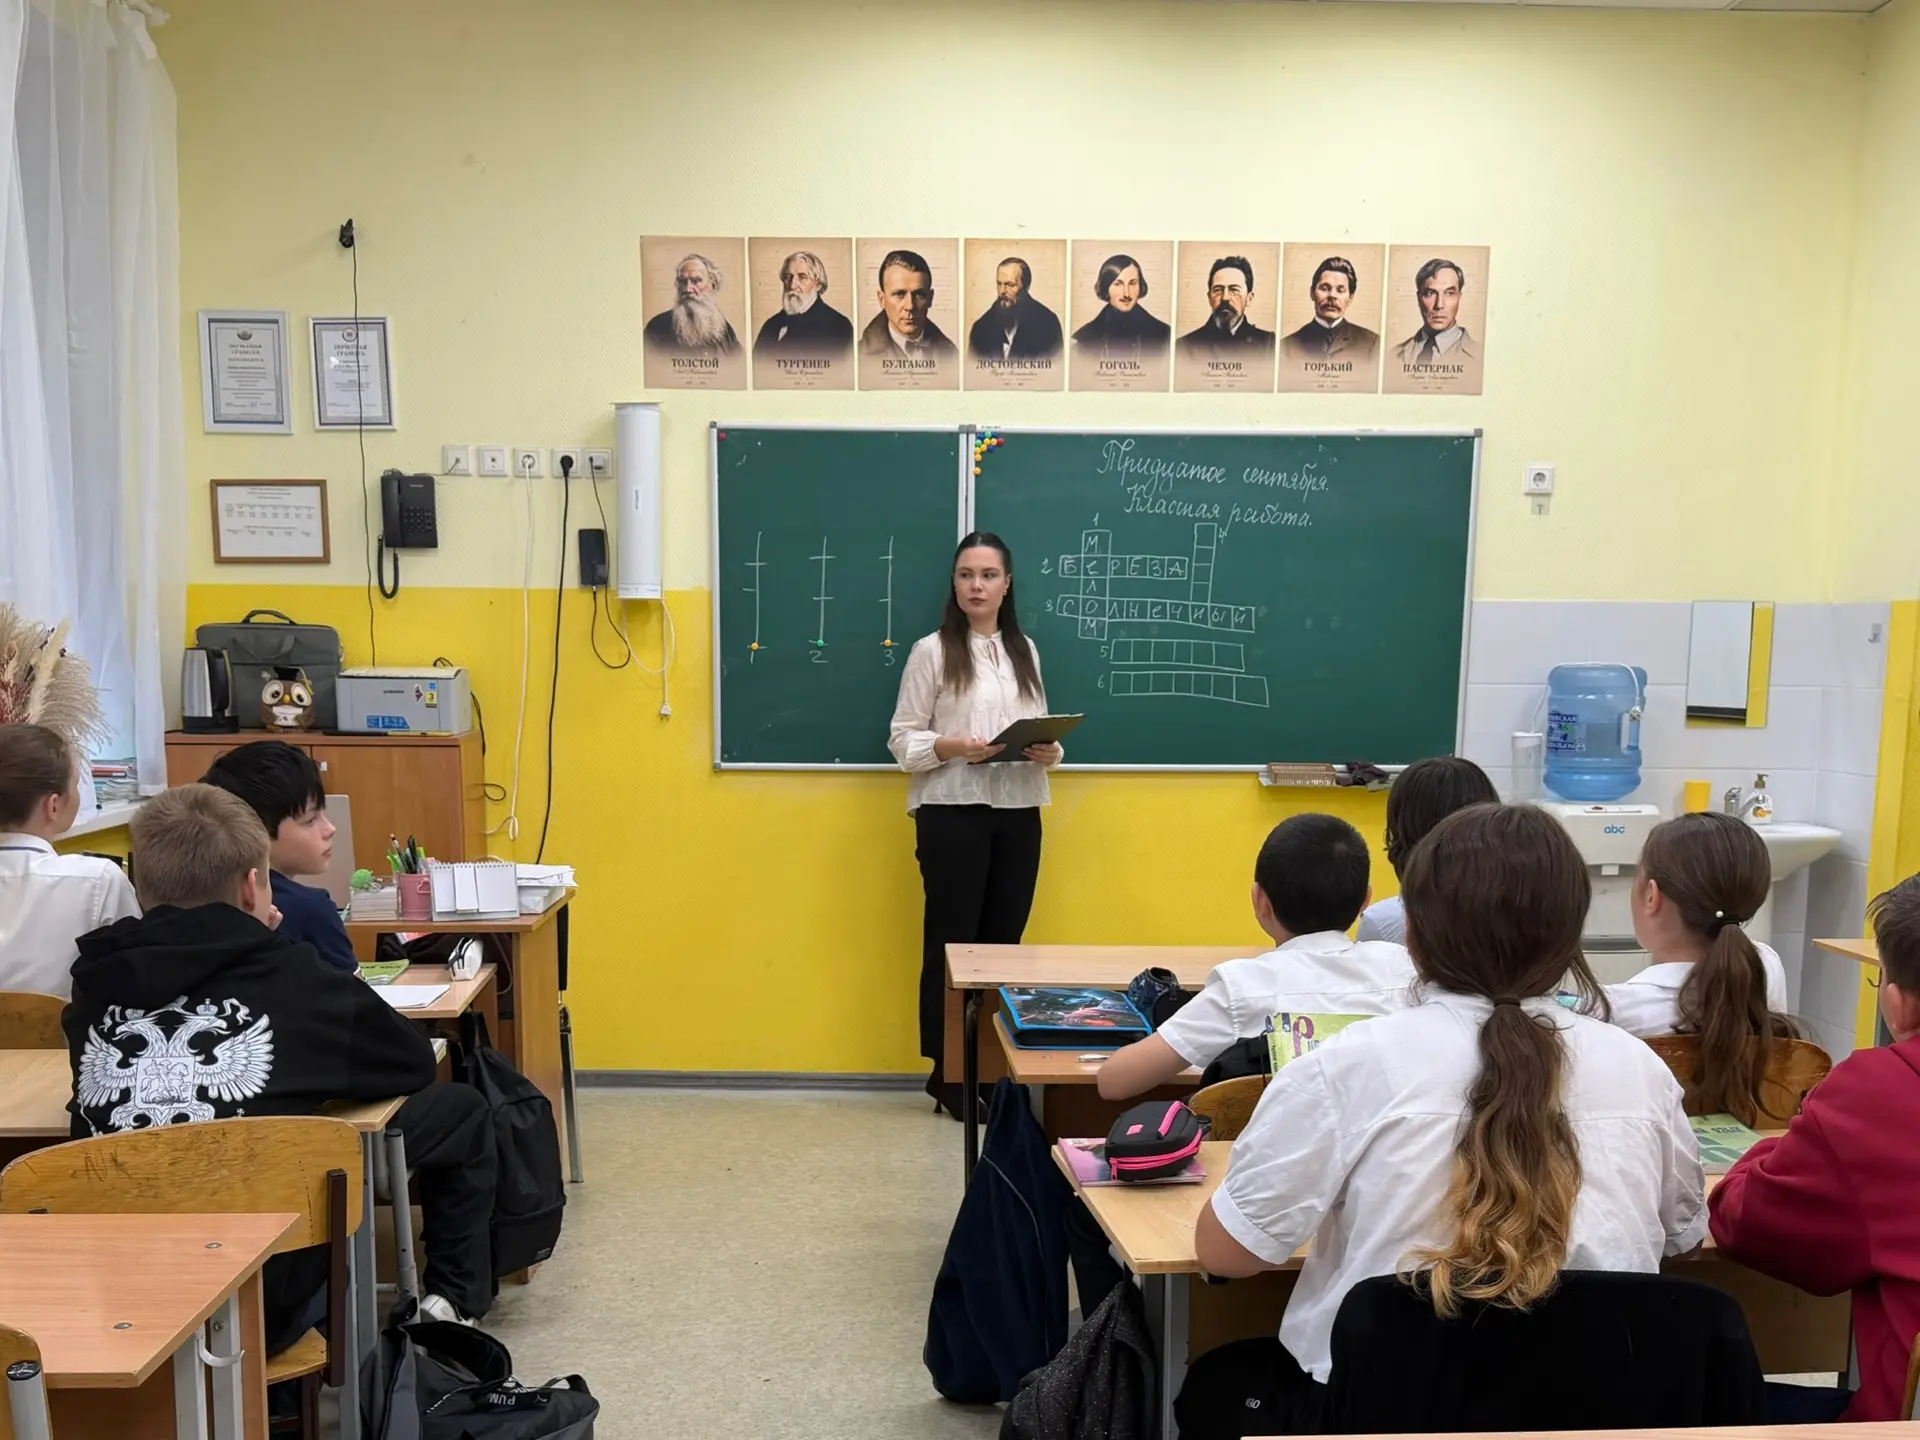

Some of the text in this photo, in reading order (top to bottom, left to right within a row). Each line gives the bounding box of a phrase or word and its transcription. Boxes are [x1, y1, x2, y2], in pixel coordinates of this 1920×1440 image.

[671, 358, 719, 368] ТОЛСТОЙ
[776, 359, 830, 369] ТУРГЕНЕВ
[882, 359, 936, 369] БУЛГАКОВ
[975, 358, 1052, 369] ДОСТОЕВСКИЙ
[1100, 360, 1140, 370] ГОГОЛЬ
[1208, 361, 1242, 371] ЧЕХОВ
[1304, 361, 1353, 372] ГОРЬКИЙ
[1403, 363, 1464, 373] ПАСТЕРНАК
[1097, 439, 1226, 498] Тридцатое
[1124, 483, 1221, 519] Классная
[1040, 557, 1054, 574] 2
[809, 650, 829, 664] 2
[884, 649, 896, 666] 3
[1604, 824, 1626, 834] abc
